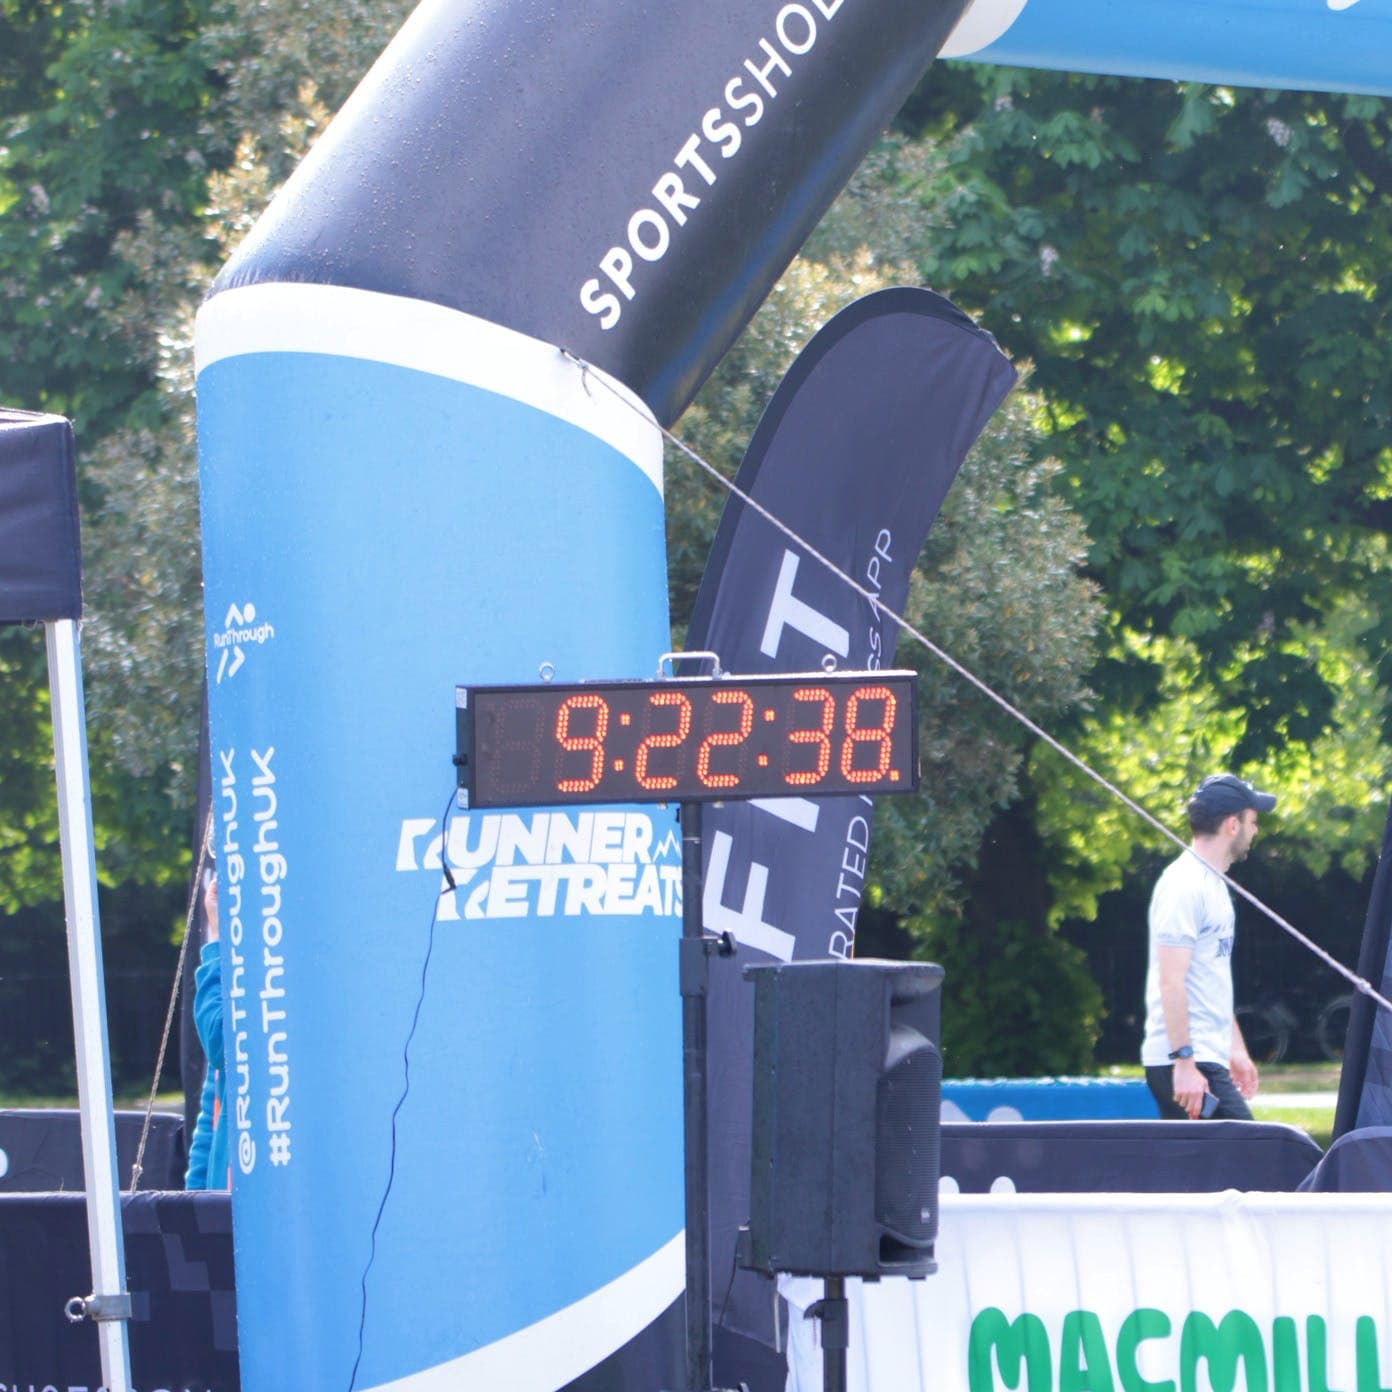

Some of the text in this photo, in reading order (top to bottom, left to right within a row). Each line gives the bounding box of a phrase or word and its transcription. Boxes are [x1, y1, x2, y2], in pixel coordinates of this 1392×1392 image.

[866, 528, 892, 622] APP
[213, 621, 275, 648] RunThrough
[396, 812, 653, 871] RUNNER
[220, 747, 257, 1175] @RunThroughUK
[250, 746, 292, 1167] #RunThroughUK
